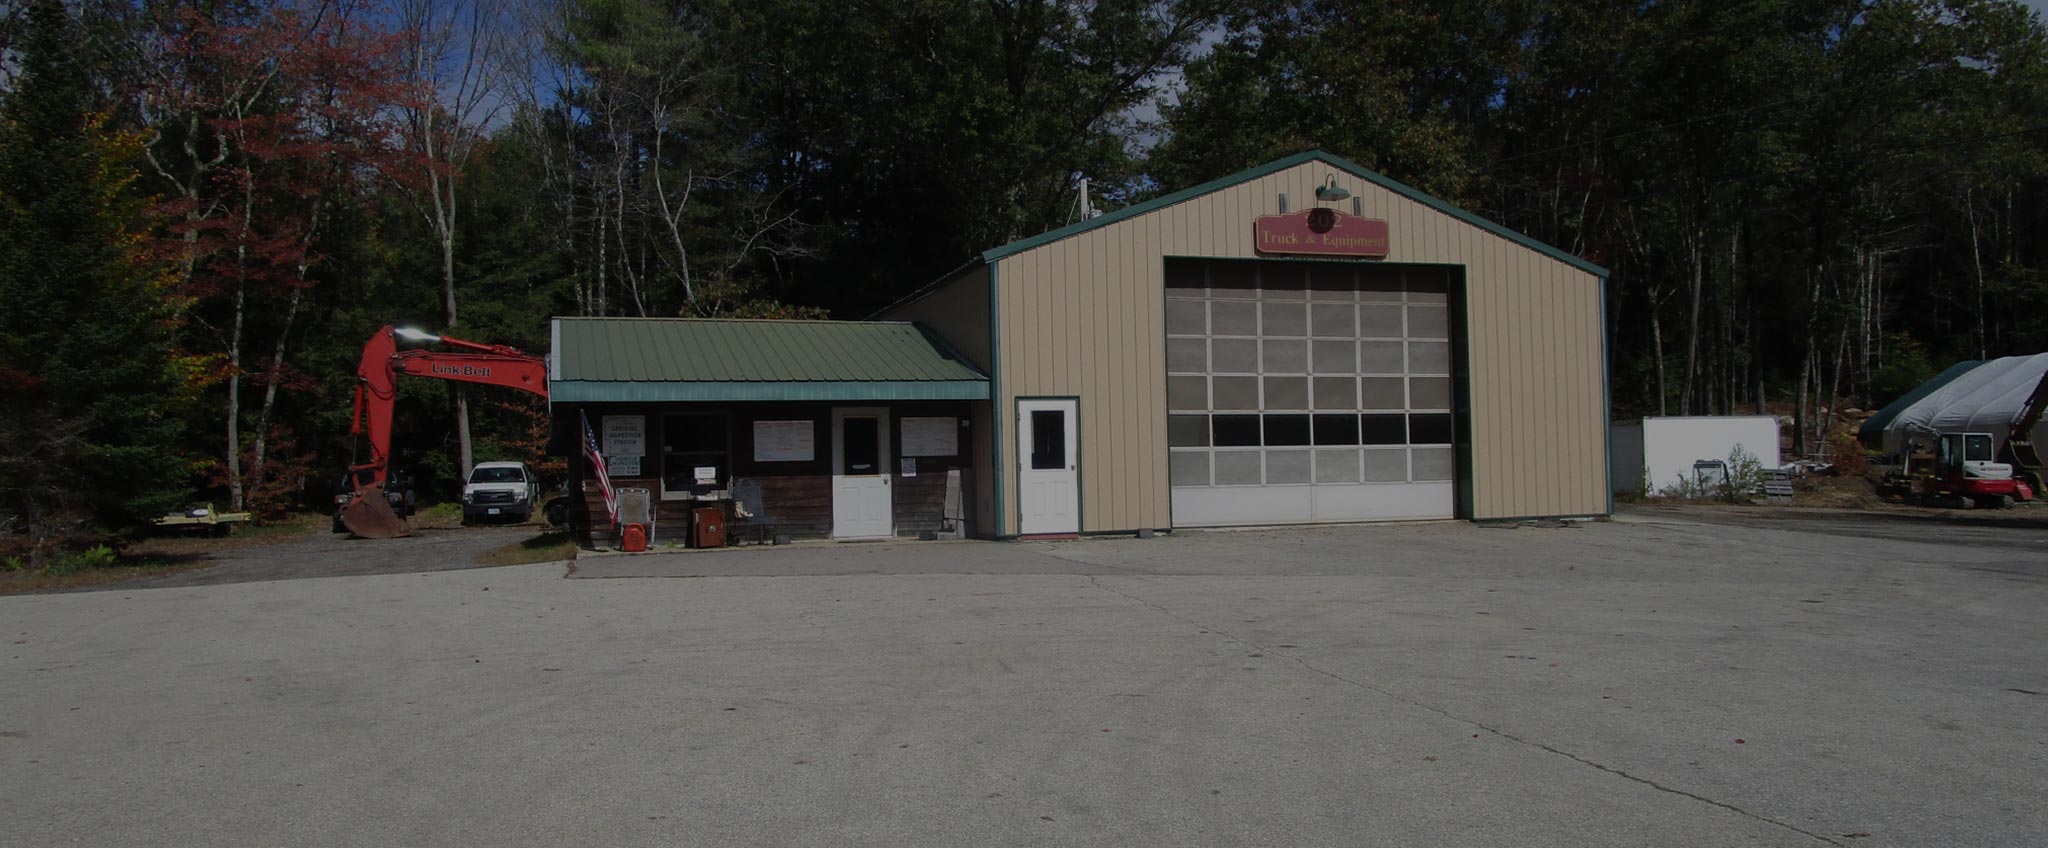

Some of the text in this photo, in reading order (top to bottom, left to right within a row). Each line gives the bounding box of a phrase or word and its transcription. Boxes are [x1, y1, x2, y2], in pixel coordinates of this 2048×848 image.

[1305, 213, 1342, 228] 202
[1262, 230, 1384, 248] Truck & Equipment
[432, 363, 491, 377] Link-Belt
